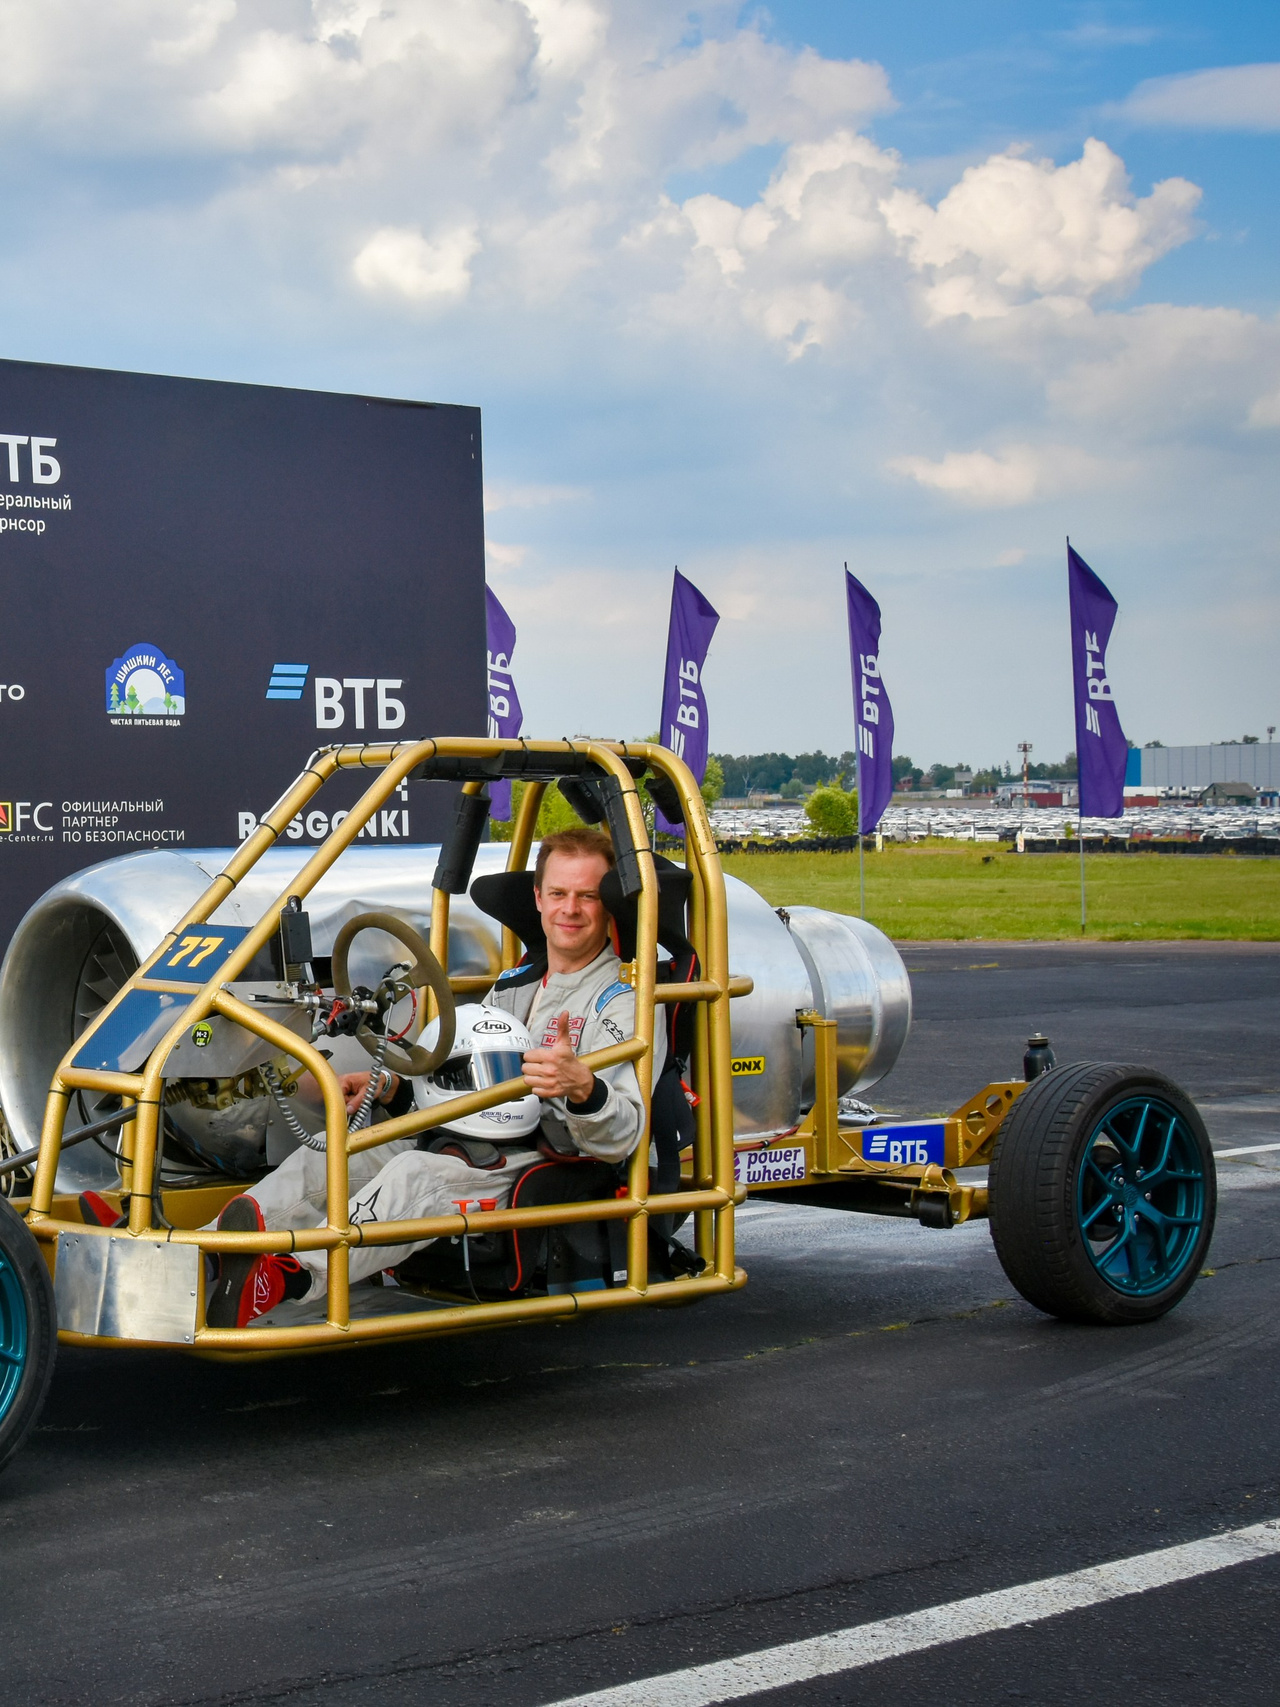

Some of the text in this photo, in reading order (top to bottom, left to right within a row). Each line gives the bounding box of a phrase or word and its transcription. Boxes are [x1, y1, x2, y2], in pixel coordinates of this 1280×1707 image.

[115, 654, 175, 685] ШИШКИН ЛЕС
[677, 658, 699, 728] ВТБ
[860, 653, 880, 725] ВТБ
[315, 678, 406, 730] ВТБ
[110, 718, 181, 727] ЧИСТАЯ ПИТЬЕВАЯ ВОДА
[16, 801, 54, 832] FC
[61, 799, 164, 813] ОФИЦИАЛЬНЫЙ
[62, 815, 119, 828] ПАРТНЕР
[62, 829, 185, 843] ПО БЕЗОПАСНОСТИ
[167, 936, 225, 967] 77
[477, 1021, 508, 1031] Arai
[747, 1148, 802, 1167] power
[889, 1139, 929, 1165] ВТБ
[747, 1163, 805, 1183] wheels
